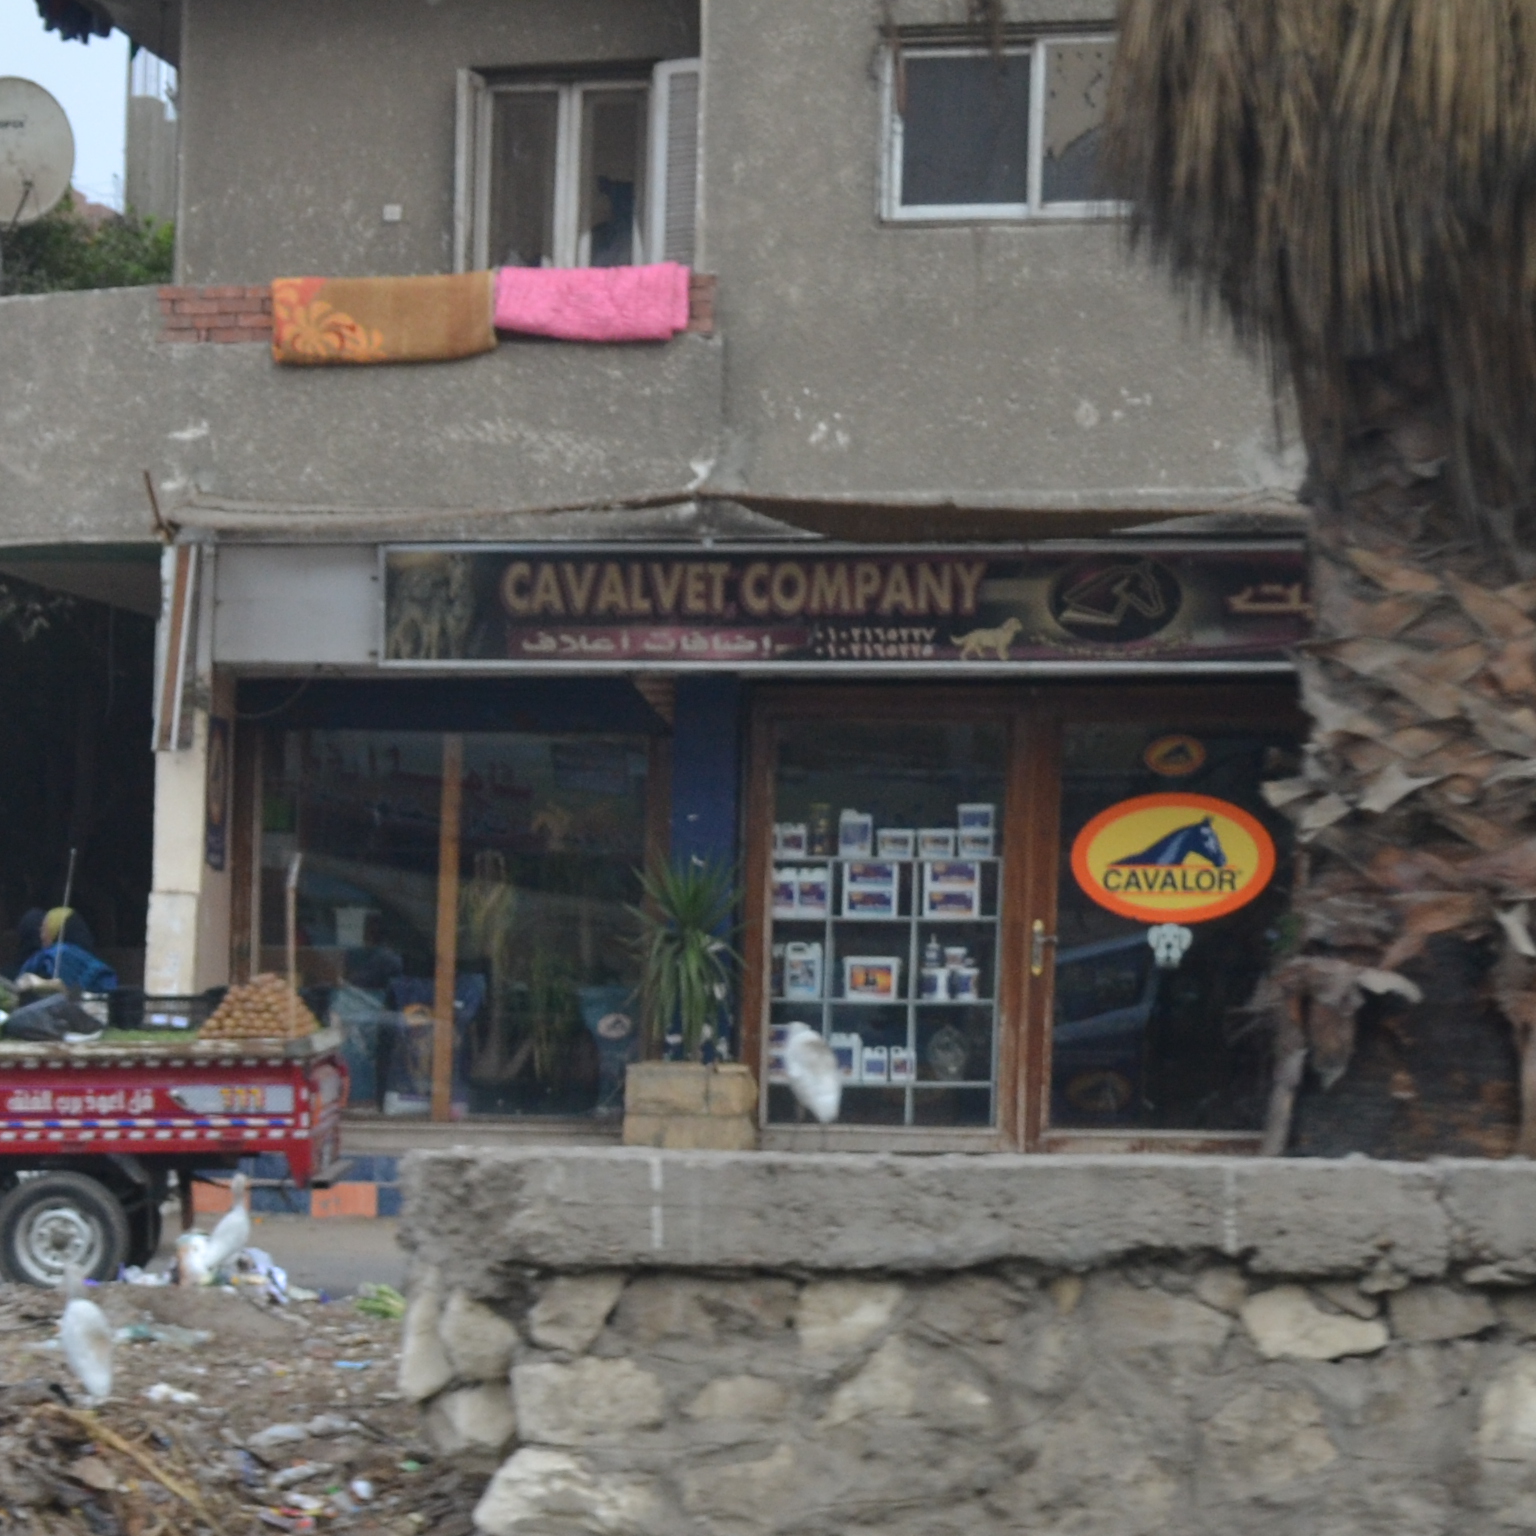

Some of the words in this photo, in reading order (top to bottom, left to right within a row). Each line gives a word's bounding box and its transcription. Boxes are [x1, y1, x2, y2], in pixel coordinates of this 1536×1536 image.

[502, 561, 730, 614] CAVALVET
[743, 561, 985, 614] COMPANY
[1103, 868, 1237, 892] CAVALOR
